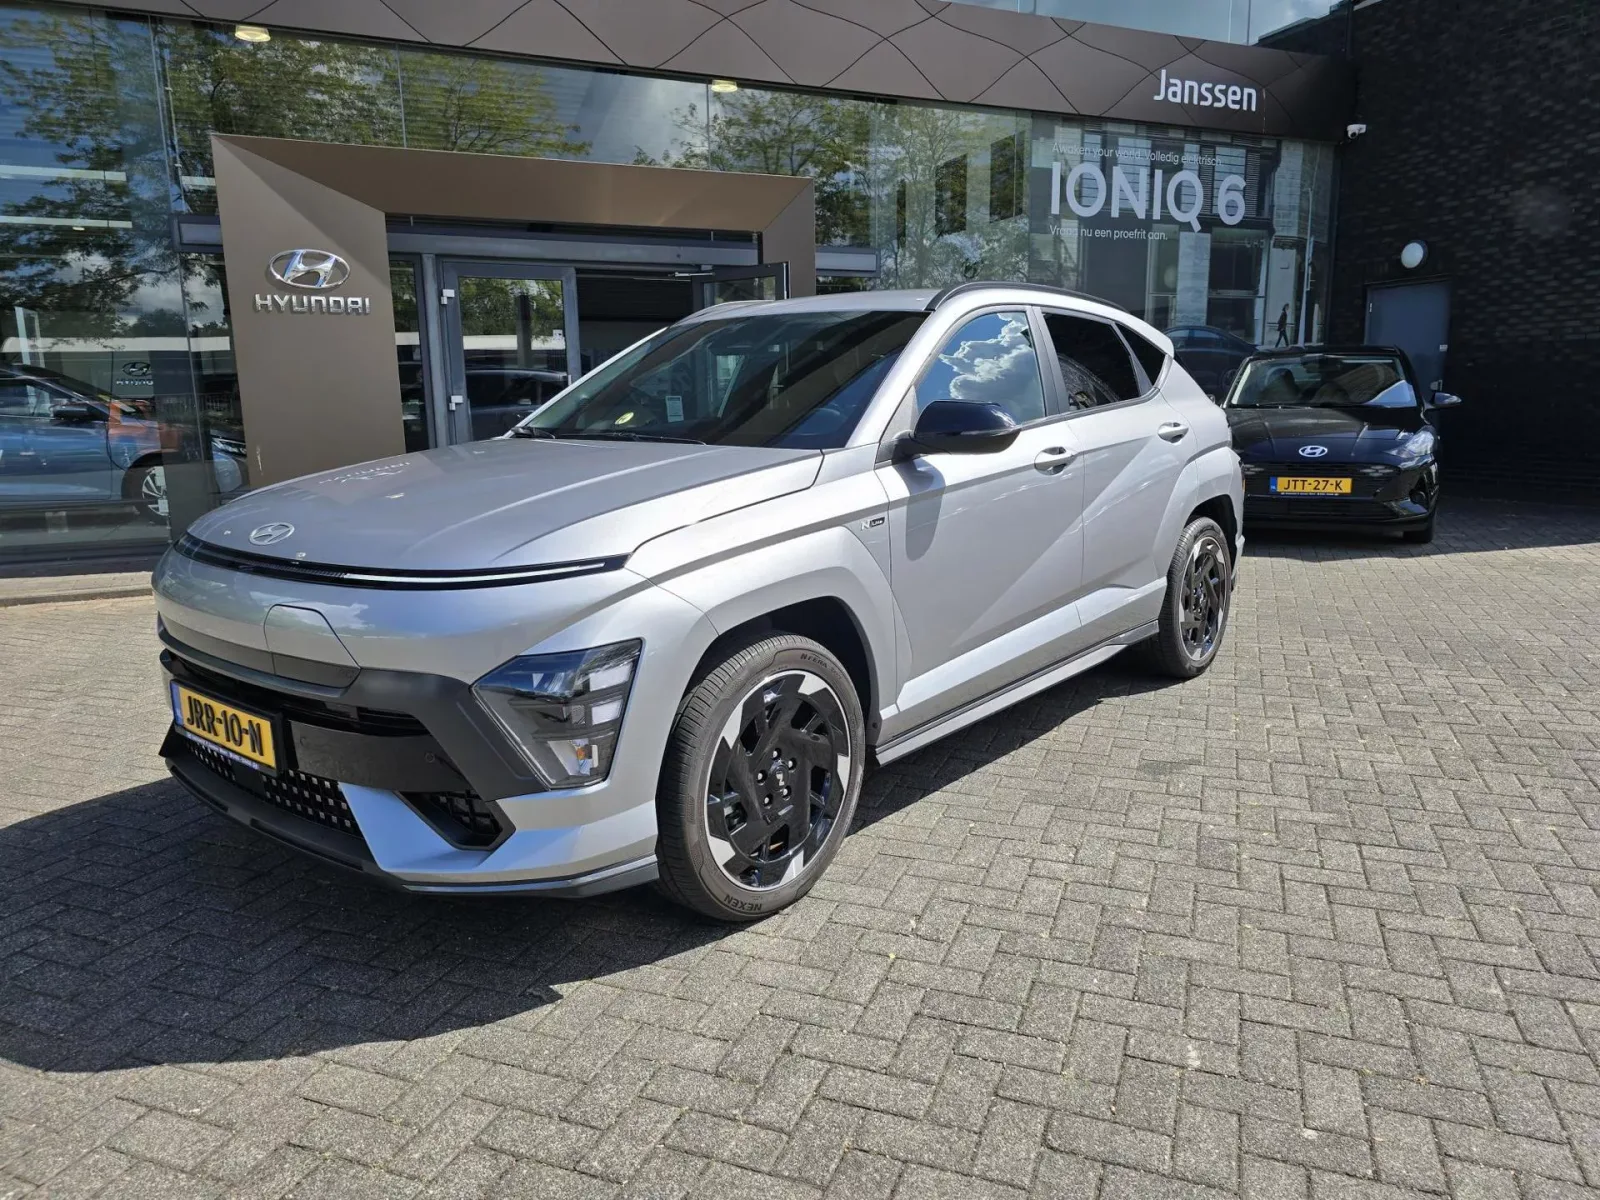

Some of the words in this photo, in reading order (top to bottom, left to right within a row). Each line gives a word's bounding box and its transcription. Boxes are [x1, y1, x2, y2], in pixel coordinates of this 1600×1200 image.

[1153, 69, 1257, 112] Janssen
[1051, 142, 1091, 156] Awaken
[1093, 148, 1114, 159] your
[1145, 150, 1179, 165] Volledig
[1181, 154, 1223, 167] elektrisch.
[1051, 162, 1203, 233] IONIQ
[1217, 174, 1247, 226] 6
[1049, 224, 1078, 238] Vraag
[1080, 228, 1093, 237] nu
[1094, 228, 1112, 238] een
[1113, 228, 1146, 241] proefrit
[1147, 230, 1168, 241] aan.
[254, 293, 371, 315] HYUNDAI
[1284, 479, 1343, 491] JTT-27-K
[187, 695, 264, 756] JRR-10-N
[723, 893, 763, 912] NEXEN
